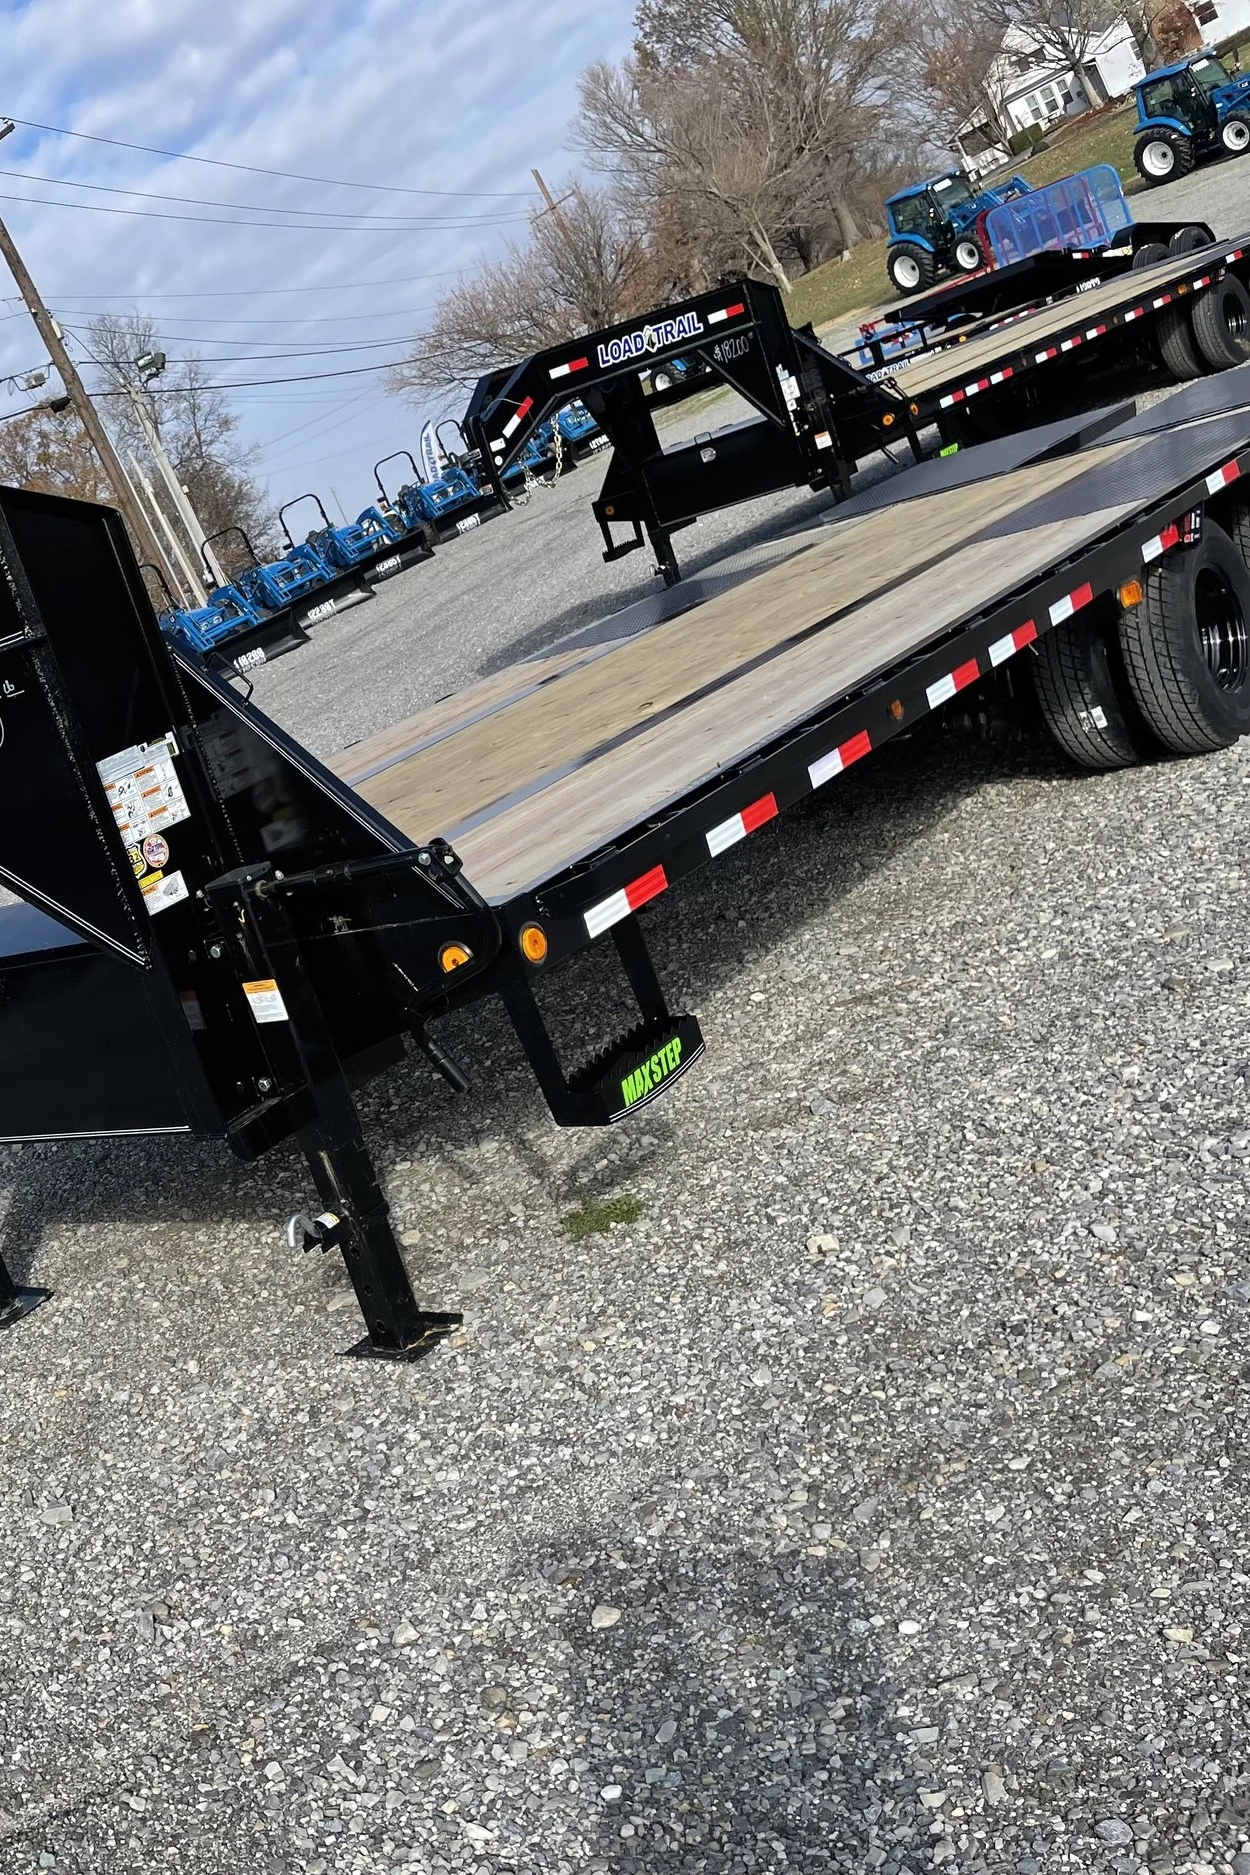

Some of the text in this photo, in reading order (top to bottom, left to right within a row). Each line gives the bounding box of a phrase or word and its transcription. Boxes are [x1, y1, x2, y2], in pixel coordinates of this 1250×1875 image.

[597, 312, 704, 368] LOAD TRAIL
[621, 1037, 681, 1107] MAX STEP
